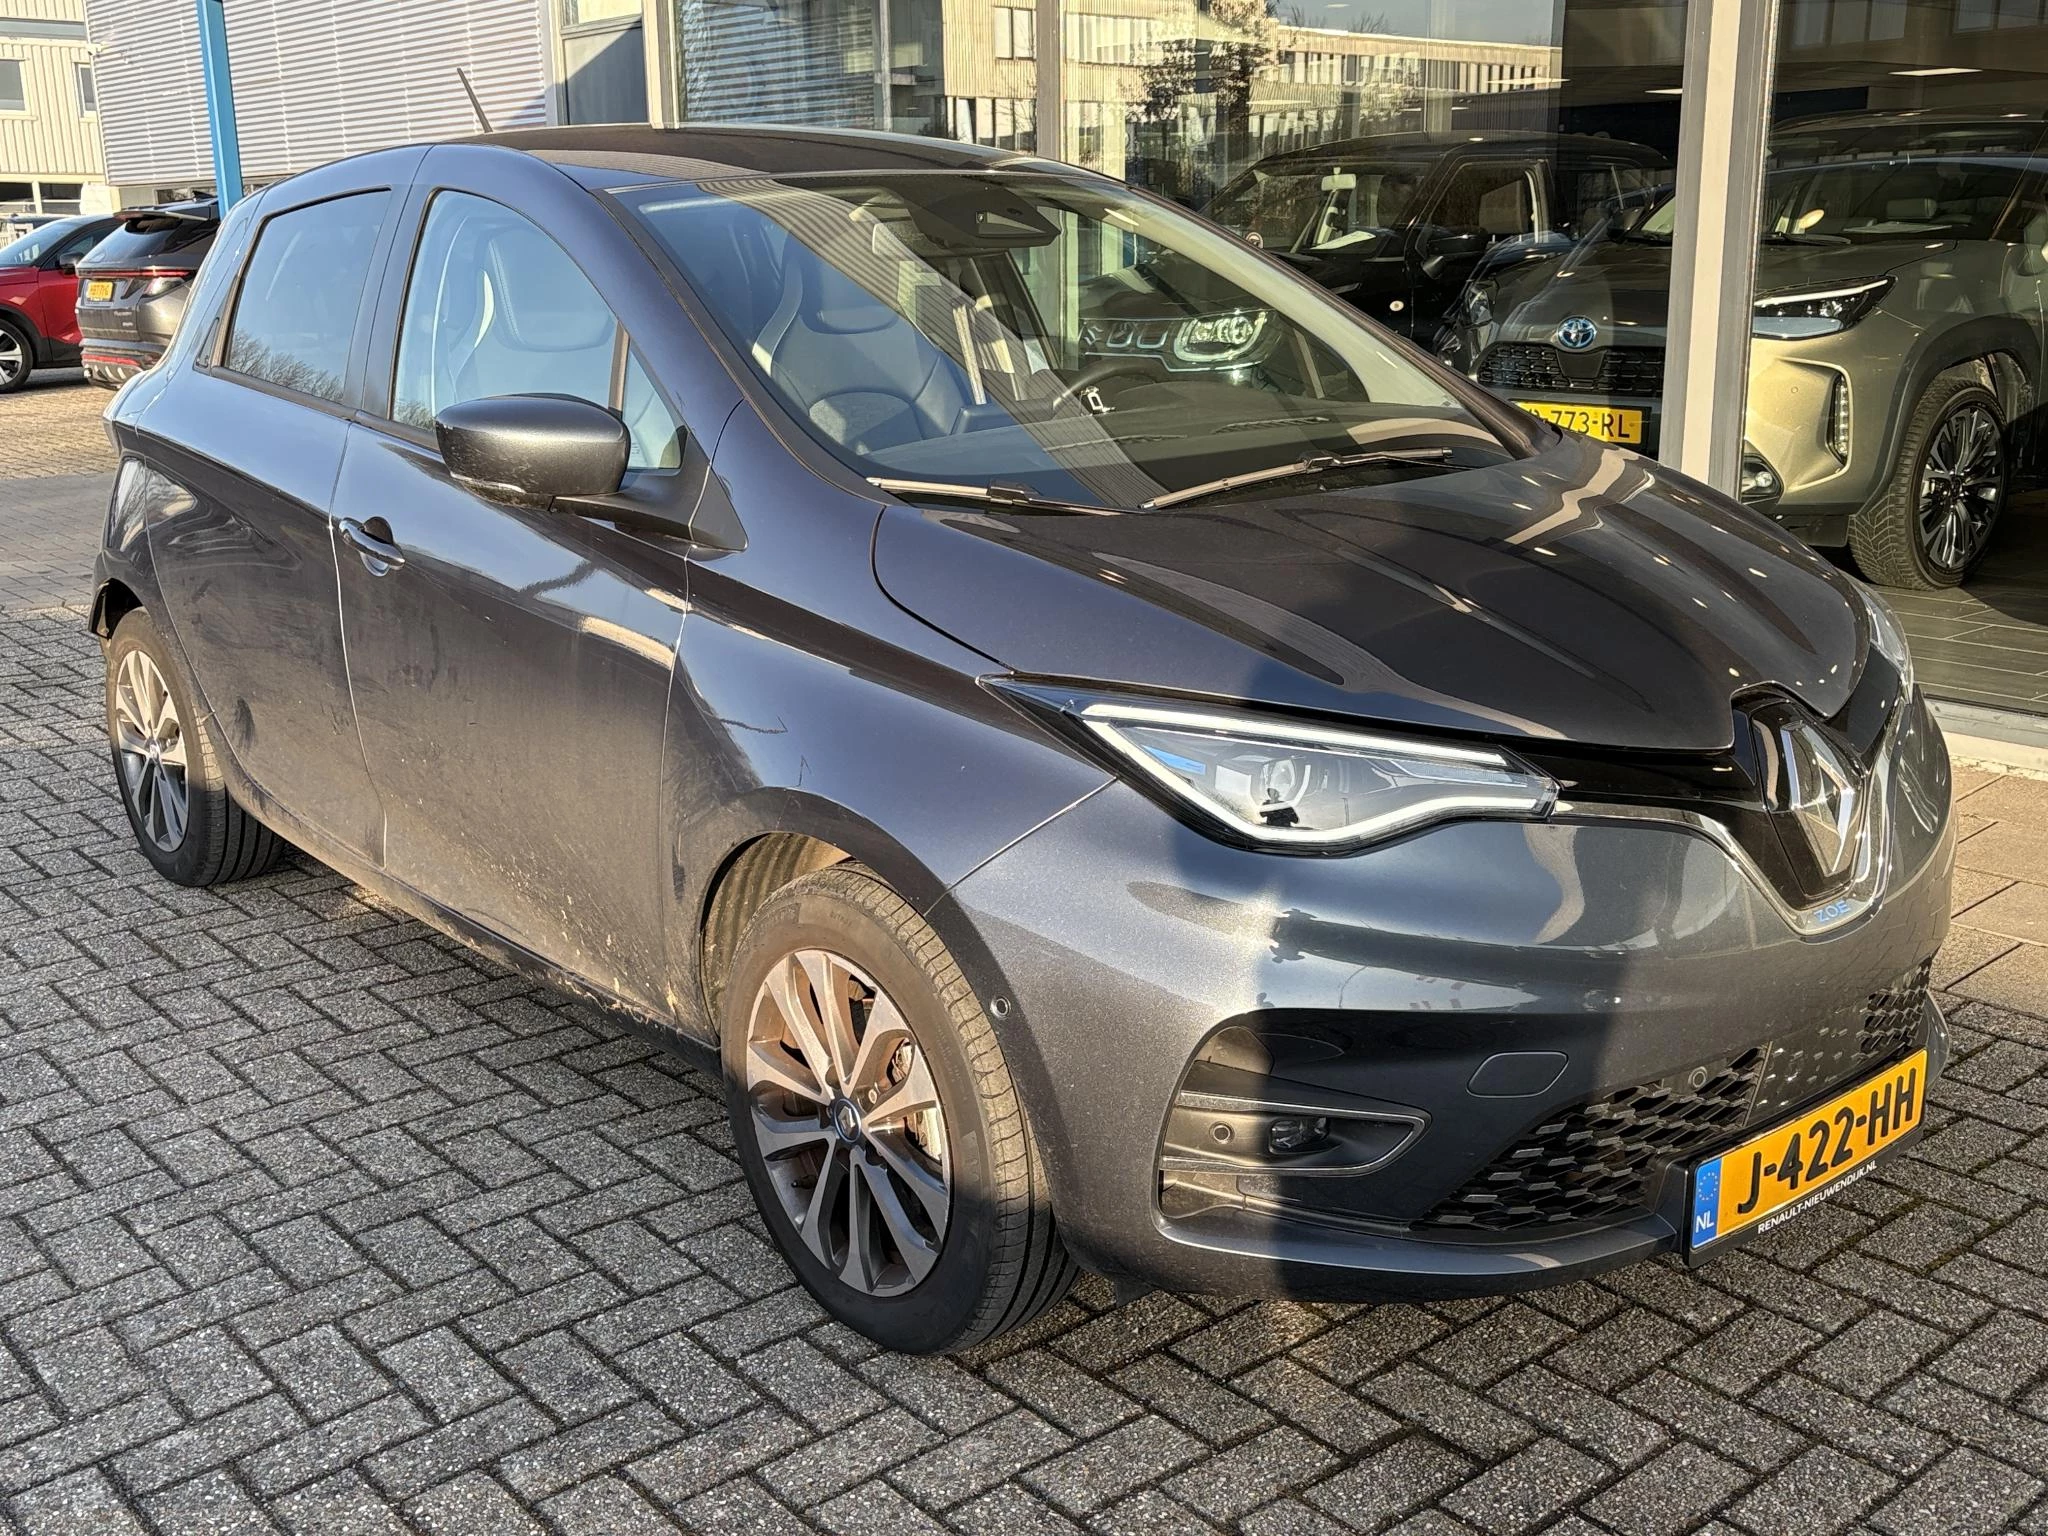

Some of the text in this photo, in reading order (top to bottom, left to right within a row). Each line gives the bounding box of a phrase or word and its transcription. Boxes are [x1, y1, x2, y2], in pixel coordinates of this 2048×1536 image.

[1813, 899, 1851, 922] ZOE
[1737, 1067, 1917, 1214] J-422-HH
[1757, 1159, 1878, 1234] RENAULT-NIEUWENDIJK.NL
[1695, 1210, 1715, 1233] NL
